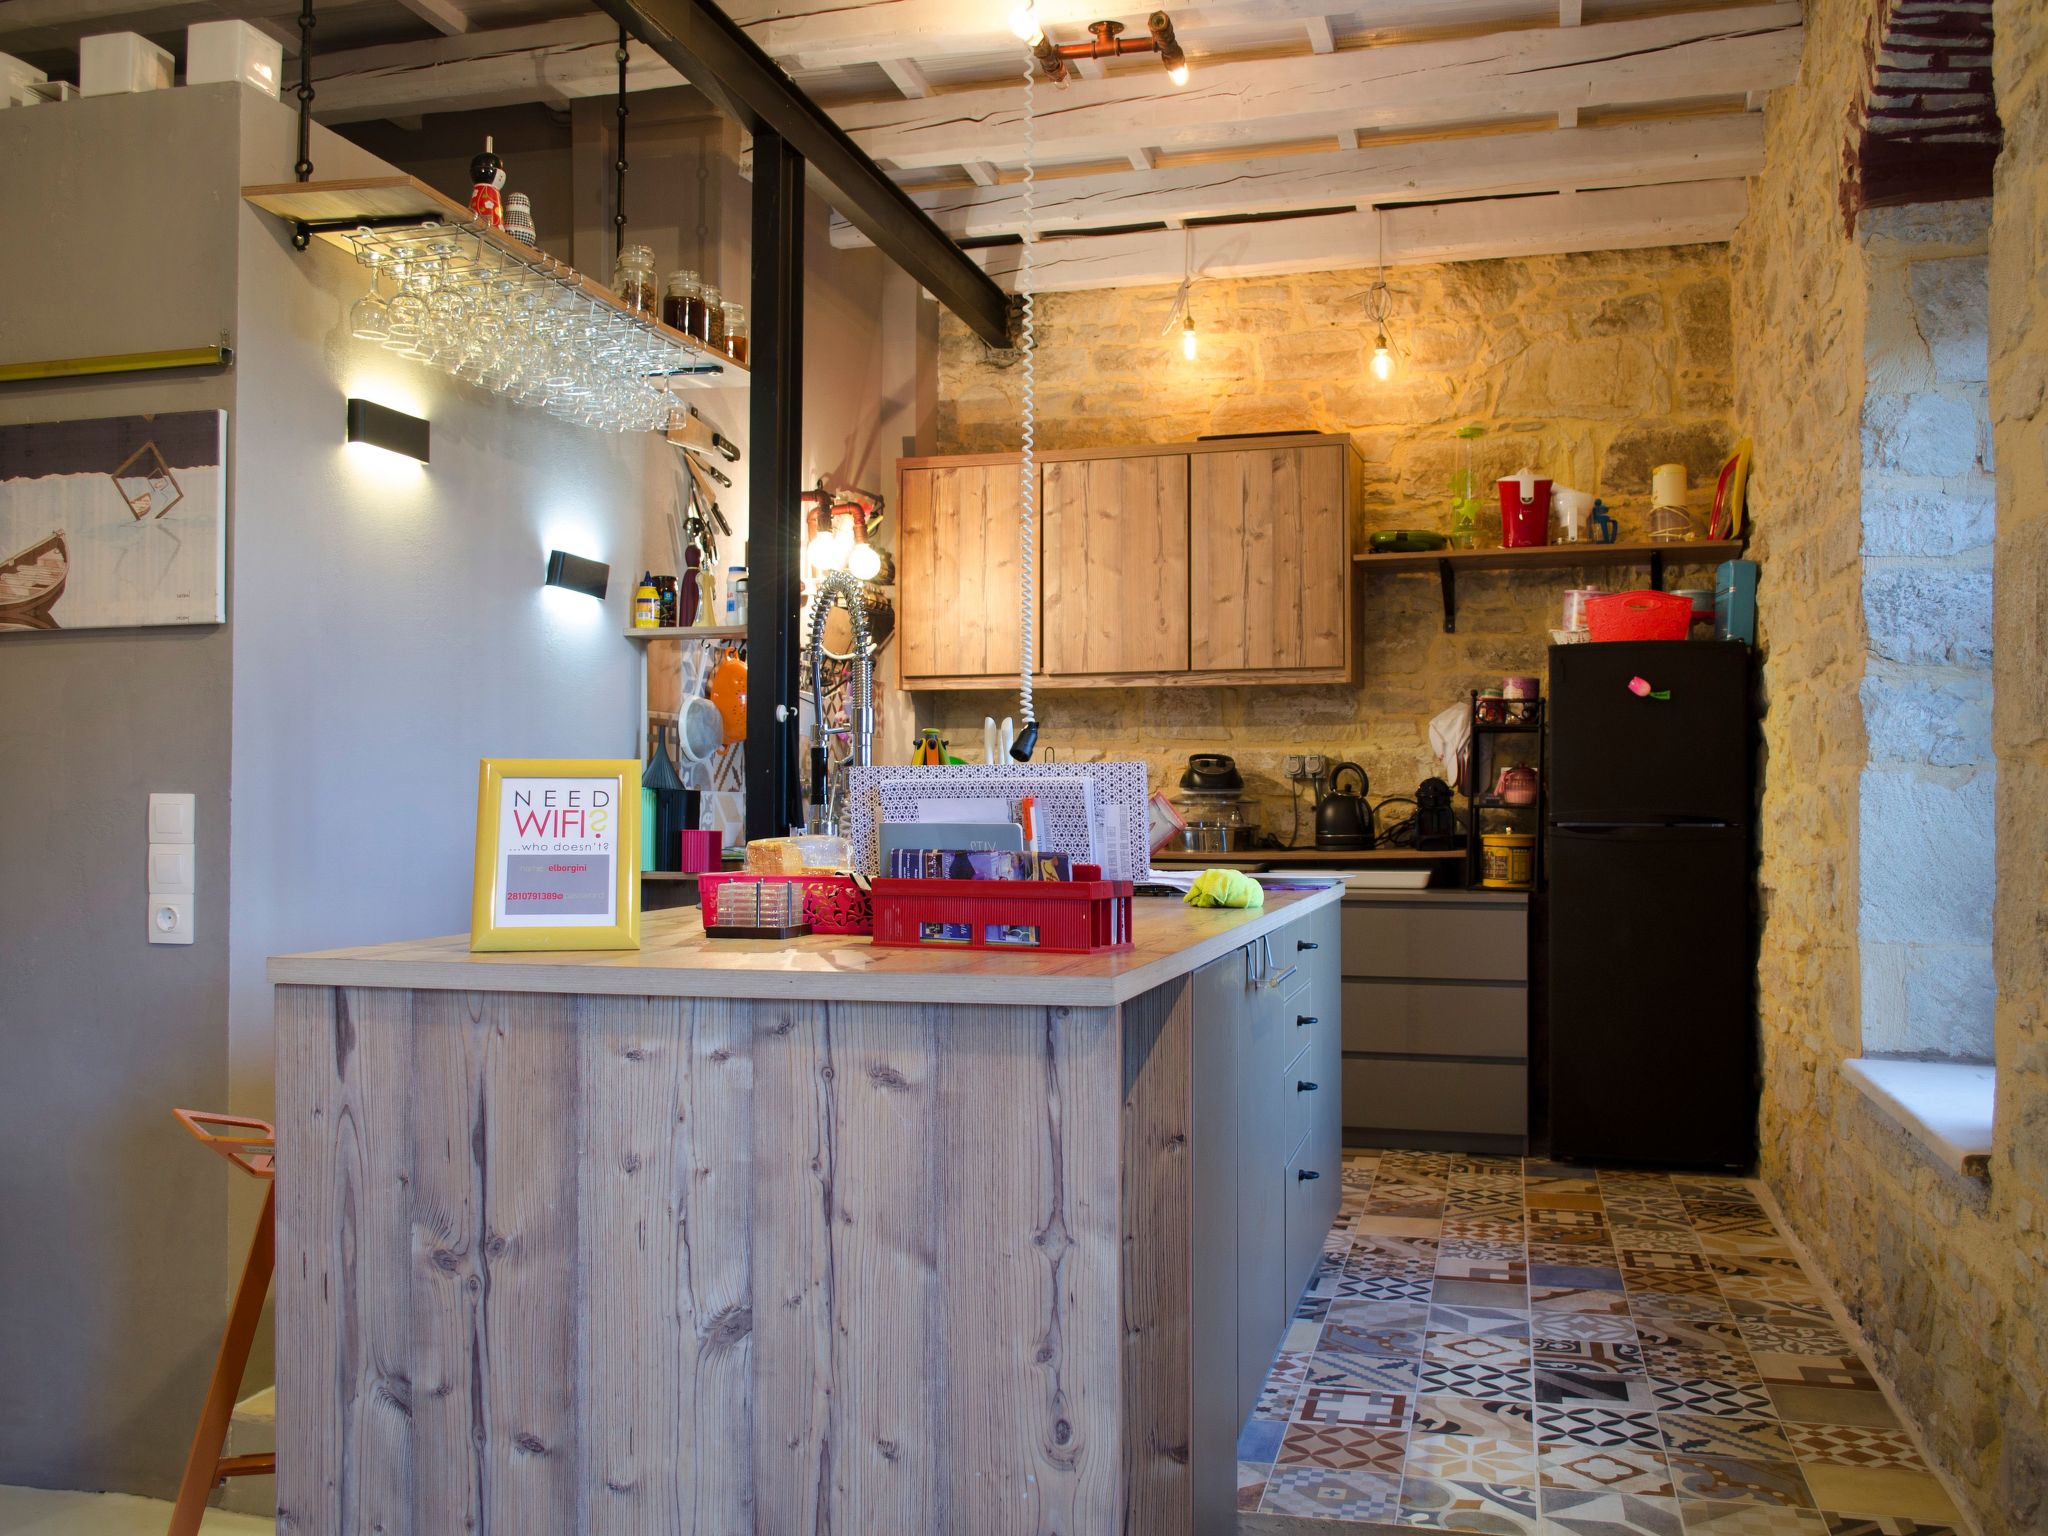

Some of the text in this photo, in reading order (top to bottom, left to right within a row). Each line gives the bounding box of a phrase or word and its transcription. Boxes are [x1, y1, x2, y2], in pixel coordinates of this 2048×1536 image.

[514, 790, 609, 808] NEED
[514, 809, 608, 838] WIFI?
[548, 864, 587, 873] elborgini
